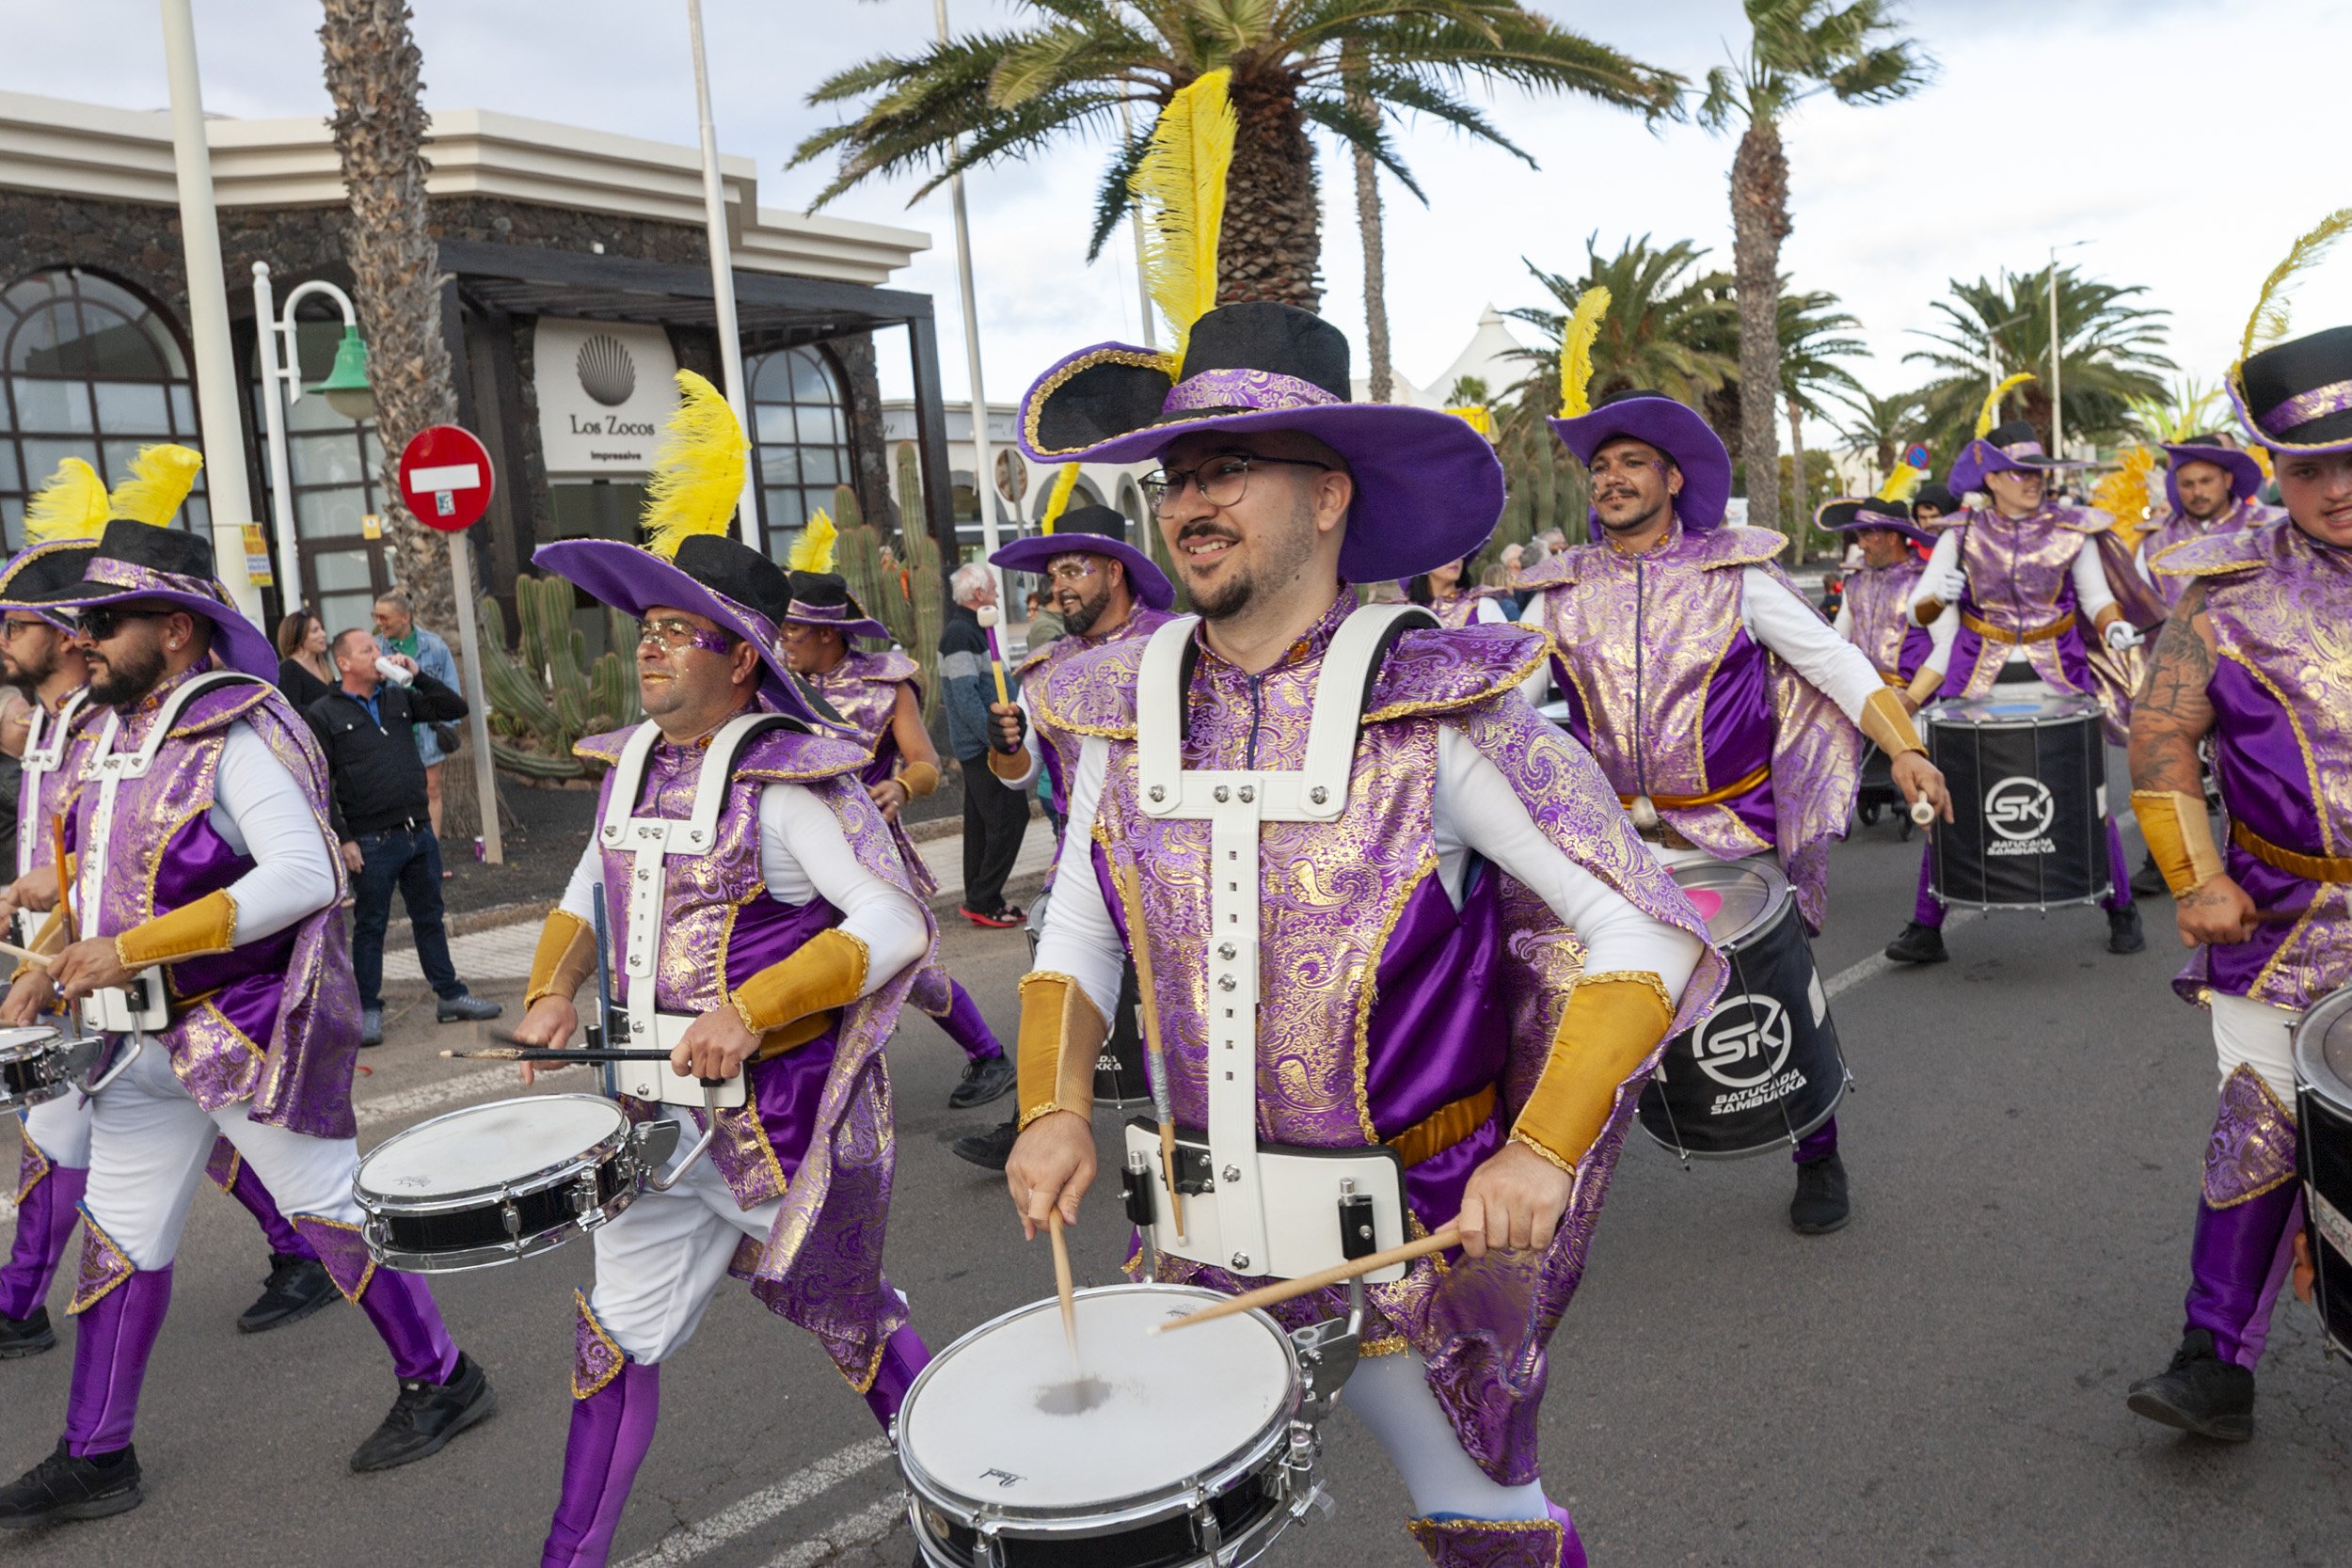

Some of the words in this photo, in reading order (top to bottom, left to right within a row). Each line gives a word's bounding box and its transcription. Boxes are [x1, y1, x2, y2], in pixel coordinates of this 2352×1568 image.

[569, 414, 601, 435] Los
[605, 415, 656, 436] Zocos
[591, 451, 642, 462] Impressive
[1710, 1075, 1806, 1116] SAMBUKKA
[1715, 1068, 1800, 1104] BATUCADA
